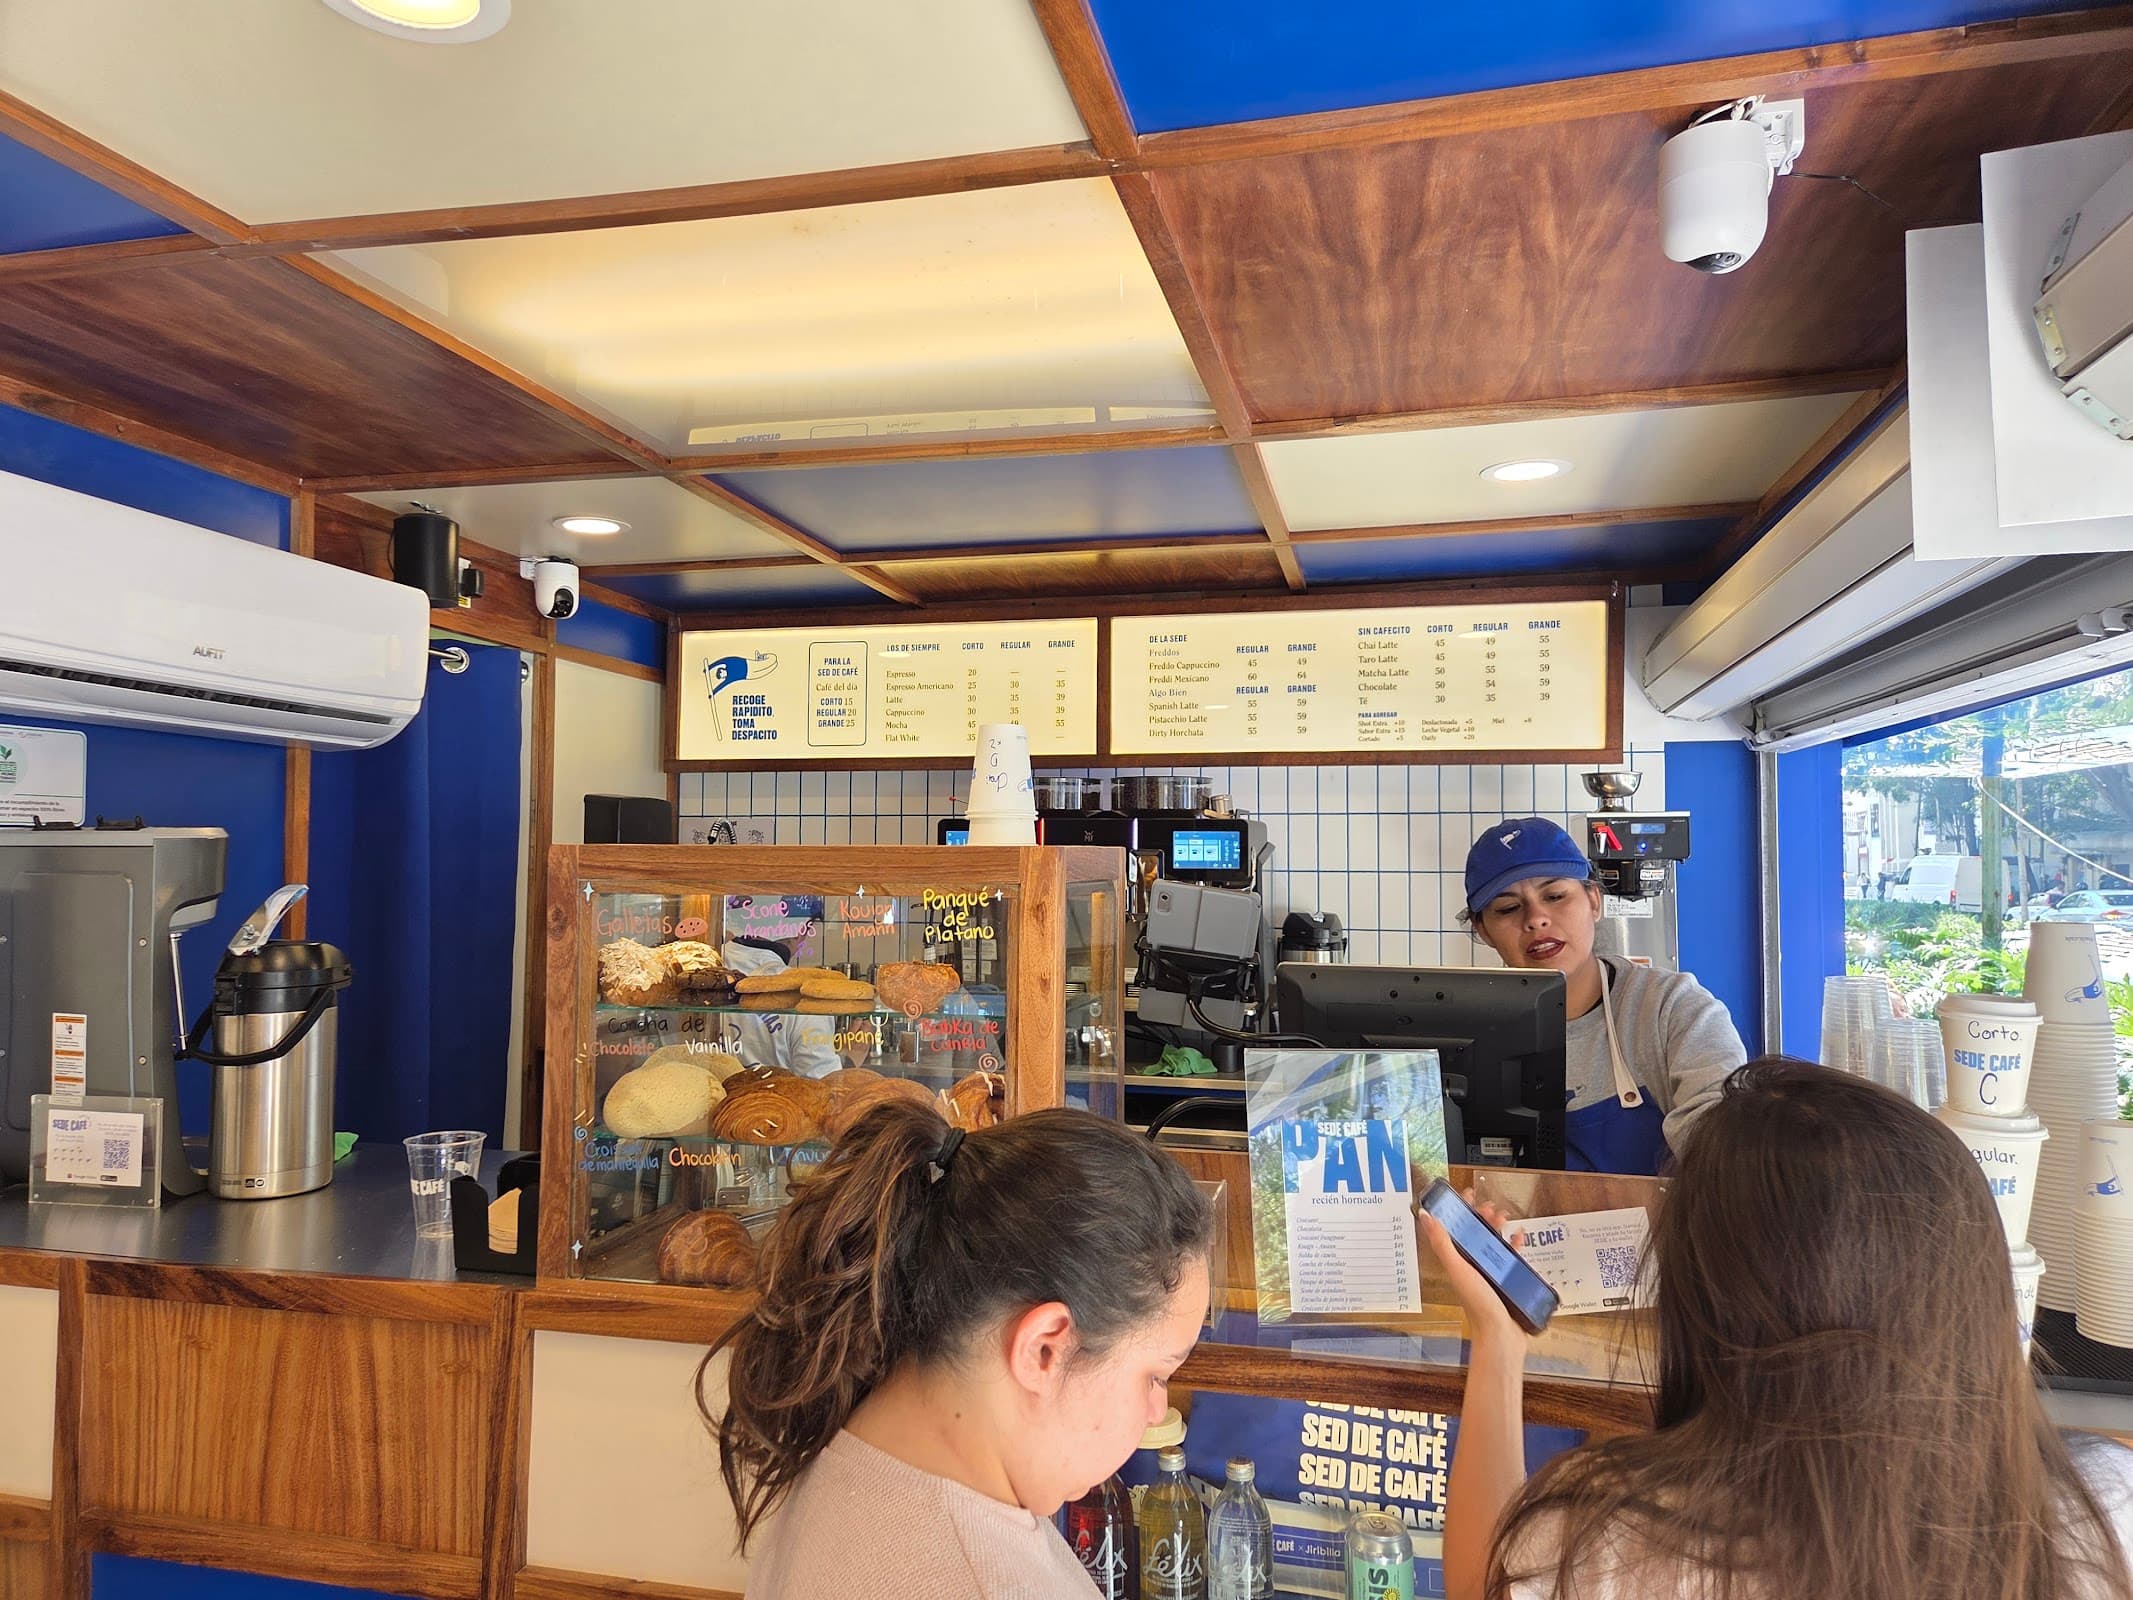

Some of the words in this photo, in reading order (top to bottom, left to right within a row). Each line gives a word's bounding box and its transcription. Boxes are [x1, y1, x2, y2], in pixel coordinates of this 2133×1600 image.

[1374, 626, 1410, 635] CAFECITO
[1427, 625, 1453, 633] CORTO
[1473, 623, 1508, 632] REGULAR
[1529, 621, 1561, 629] GRANDE
[1288, 644, 1317, 652] GRANDE
[1358, 642, 1376, 650] Chai
[1378, 641, 1398, 649] Latte
[1149, 649, 1180, 657] Freddos
[1358, 656, 1376, 664] Taro
[1378, 655, 1398, 663] Latte
[1539, 650, 1549, 658] 55
[842, 668, 858, 676] CAFÉ
[1177, 661, 1220, 670] Cappuccino
[1175, 675, 1209, 683] Mexicano
[1358, 669, 1386, 677] Matcha
[1389, 669, 1409, 677] Latte
[917, 682, 954, 690] Americano
[1236, 686, 1269, 694] REGULAR
[1288, 685, 1317, 693] GRANDE
[1358, 683, 1397, 691] Chocolate
[733, 696, 765, 704] RECOGE
[1359, 697, 1368, 705] Té
[1485, 694, 1496, 702] 35
[1149, 703, 1177, 711] Spanish
[733, 719, 755, 728] TOMA
[1189, 715, 1207, 723] Latte
[732, 730, 777, 740] DESPACITO
[1170, 729, 1203, 737] Horchata
[923, 886, 989, 917] Panqué
[741, 900, 789, 919] Scone
[597, 909, 672, 936] Galletas
[943, 911, 968, 927] de
[744, 920, 817, 939] Arandanos
[843, 923, 895, 939] Amann
[925, 925, 994, 944] Platano
[608, 1017, 668, 1033] Concha
[681, 1016, 704, 1032] de
[979, 1020, 999, 1034] de
[685, 1037, 743, 1054] Vainilla
[1954, 1049, 1984, 1071] SEDE
[1990, 1054, 2021, 1071] CAFÉ
[1979, 1073, 1997, 1105] C
[1318, 1122, 1341, 1137] SEDE
[1343, 1120, 1368, 1137] CAFÉ
[1282, 1120, 1408, 1193] PAN
[1972, 1148, 2018, 1164] gular.
[1990, 1176, 2016, 1196] AFÉ
[1312, 1195, 1339, 1204] recién
[1342, 1195, 1382, 1204] horneado
[1538, 1227, 1564, 1246] CAFÉ
[1302, 1413, 1348, 1452] SED
[1352, 1422, 1383, 1459] DE
[1386, 1431, 1447, 1469] CAFÉ
[1298, 1453, 1346, 1489] SED
[1349, 1461, 1381, 1495] DE
[1385, 1470, 1446, 1504] CAFÉ
[1276, 1539, 1294, 1552] CAFÉ
[1305, 1545, 1340, 1557] Jiribilla
